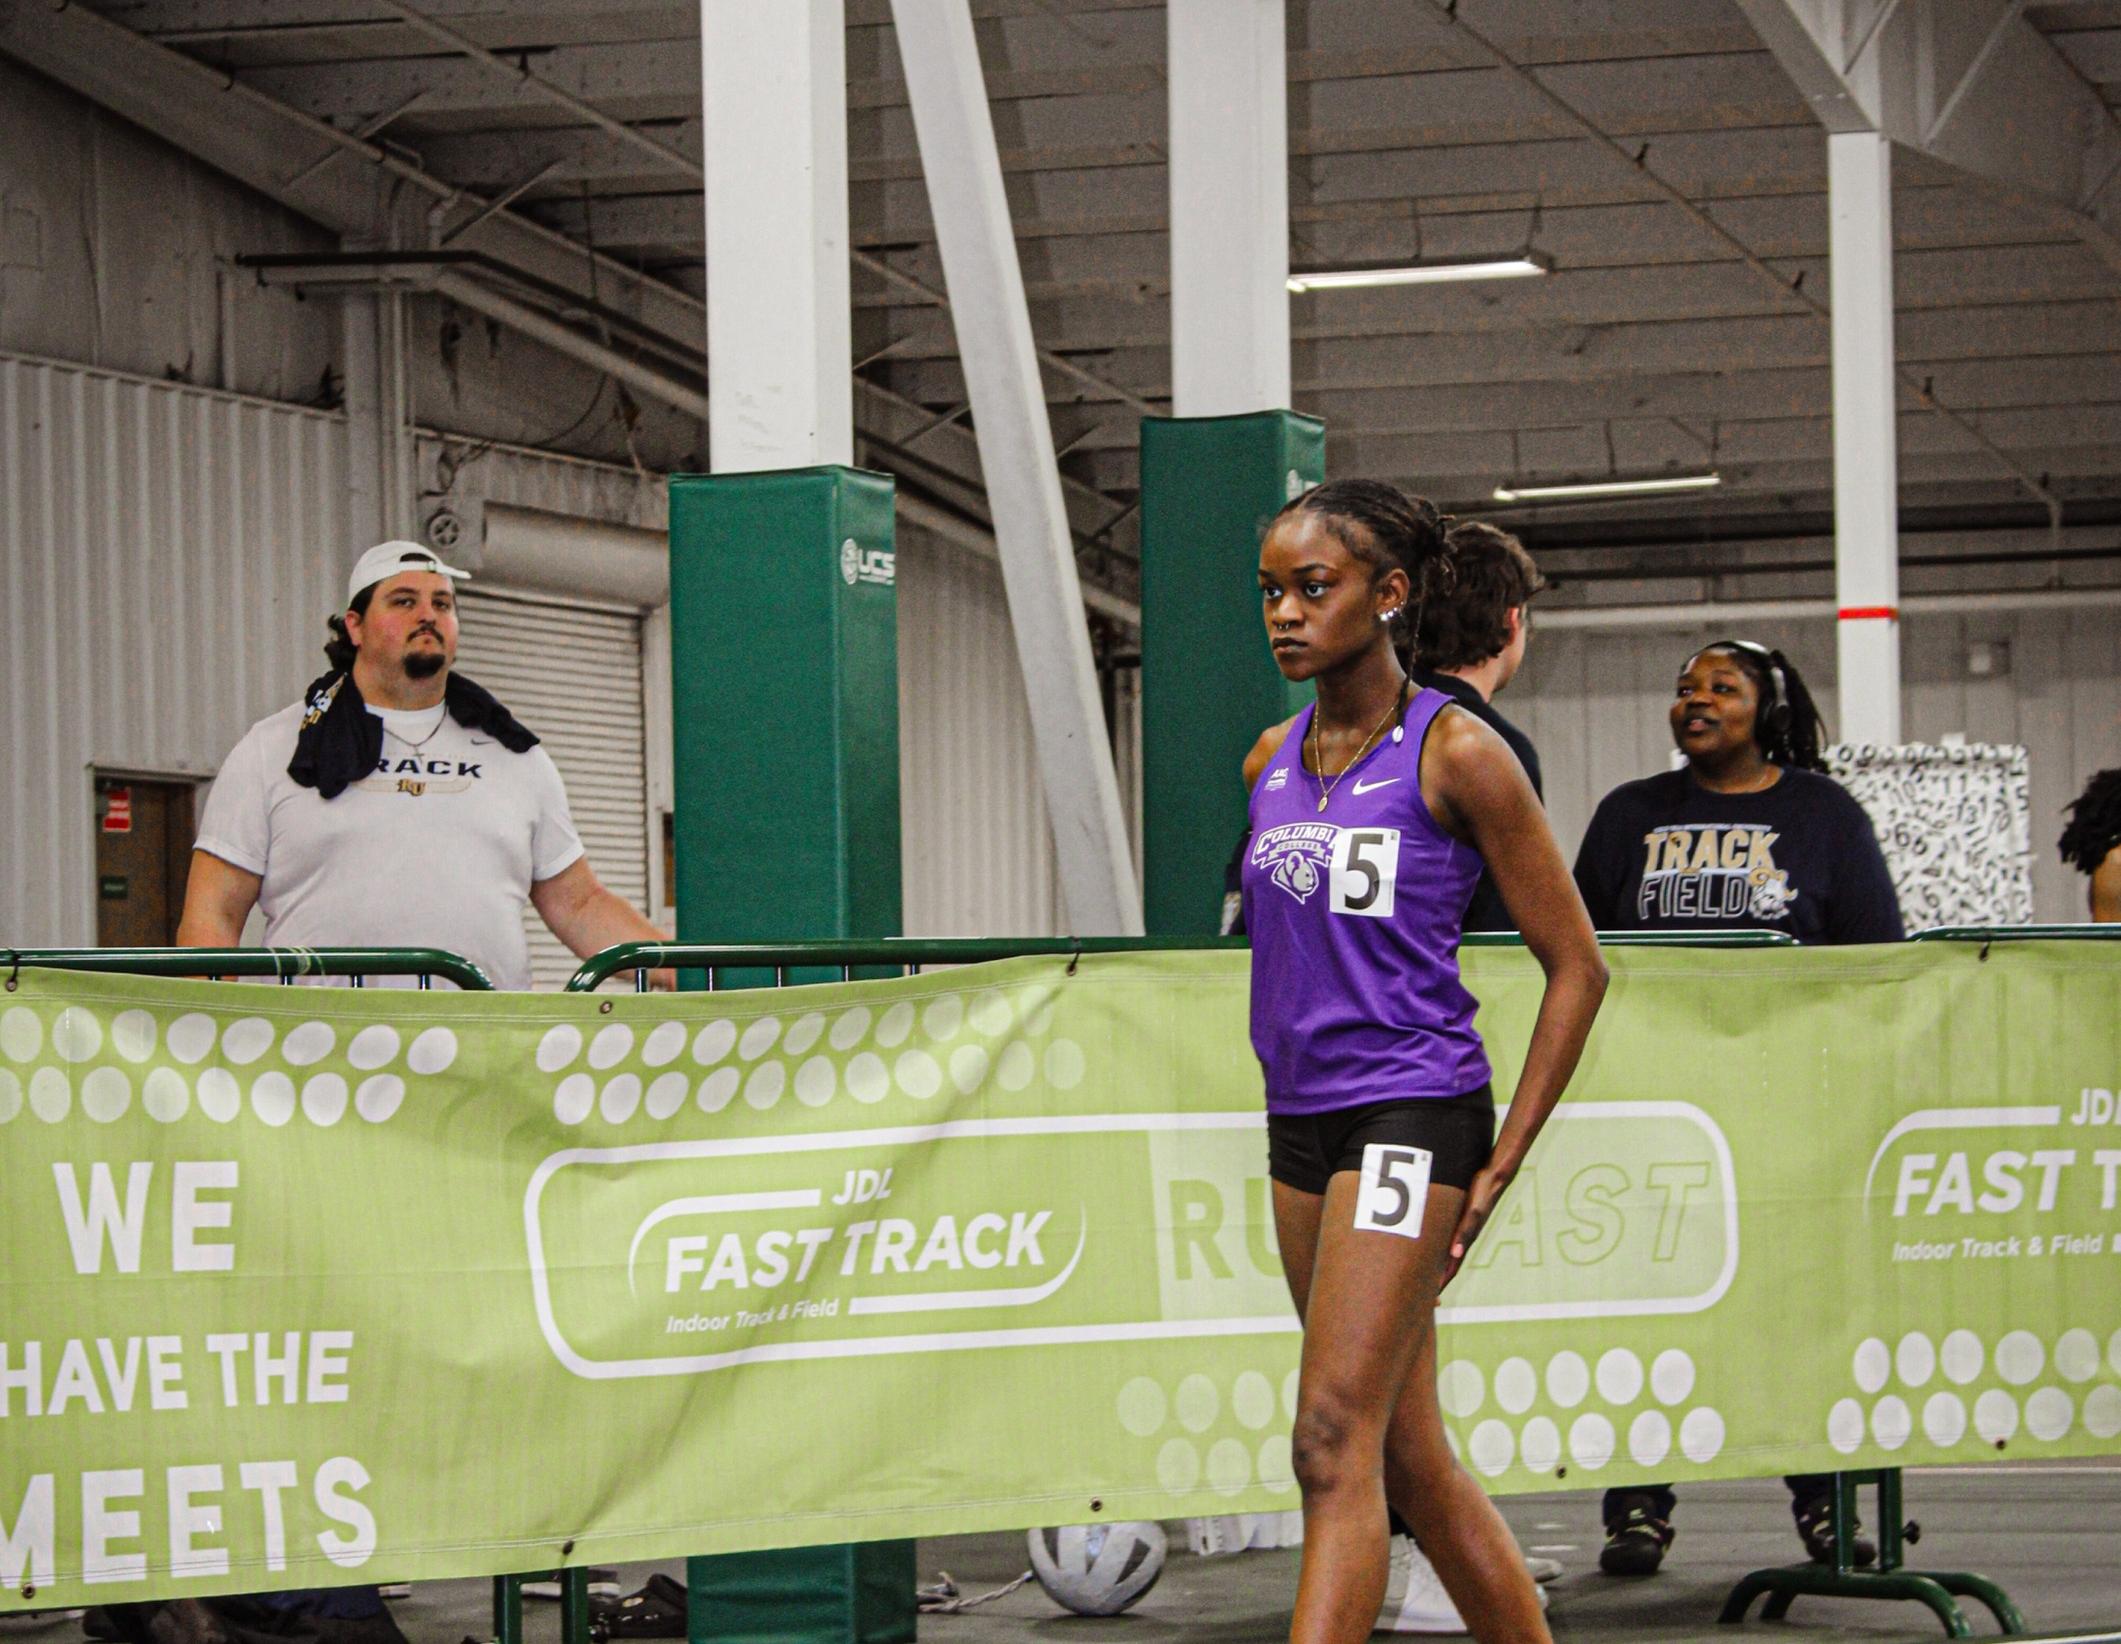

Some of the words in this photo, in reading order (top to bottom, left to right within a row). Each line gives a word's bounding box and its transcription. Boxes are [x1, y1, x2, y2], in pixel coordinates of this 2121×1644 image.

[376, 758, 482, 779] RACK
[1344, 833, 1384, 910] 5
[1643, 828, 1781, 876] TRACK
[1637, 872, 1750, 921] FIELD
[831, 1168, 894, 1206] JDL
[1371, 1150, 1415, 1226] 5
[1892, 1150, 2076, 1217] FAST
[53, 1161, 239, 1275] WE
[1168, 1177, 1286, 1280] RU
[1466, 1162, 1712, 1269] AST
[1892, 1240, 1957, 1262] Indoor
[1962, 1235, 2021, 1258] Track
[2028, 1235, 2043, 1256] &
[2051, 1233, 2104, 1255] Field
[665, 1227, 835, 1293] FAST
[839, 1211, 1053, 1276] TRACK
[665, 1313, 731, 1334] Indoor
[735, 1306, 777, 1328] Track
[776, 1303, 790, 1321] &
[790, 1297, 840, 1319] Field
[0, 1336, 189, 1417] HAVE
[206, 1331, 354, 1408] THE
